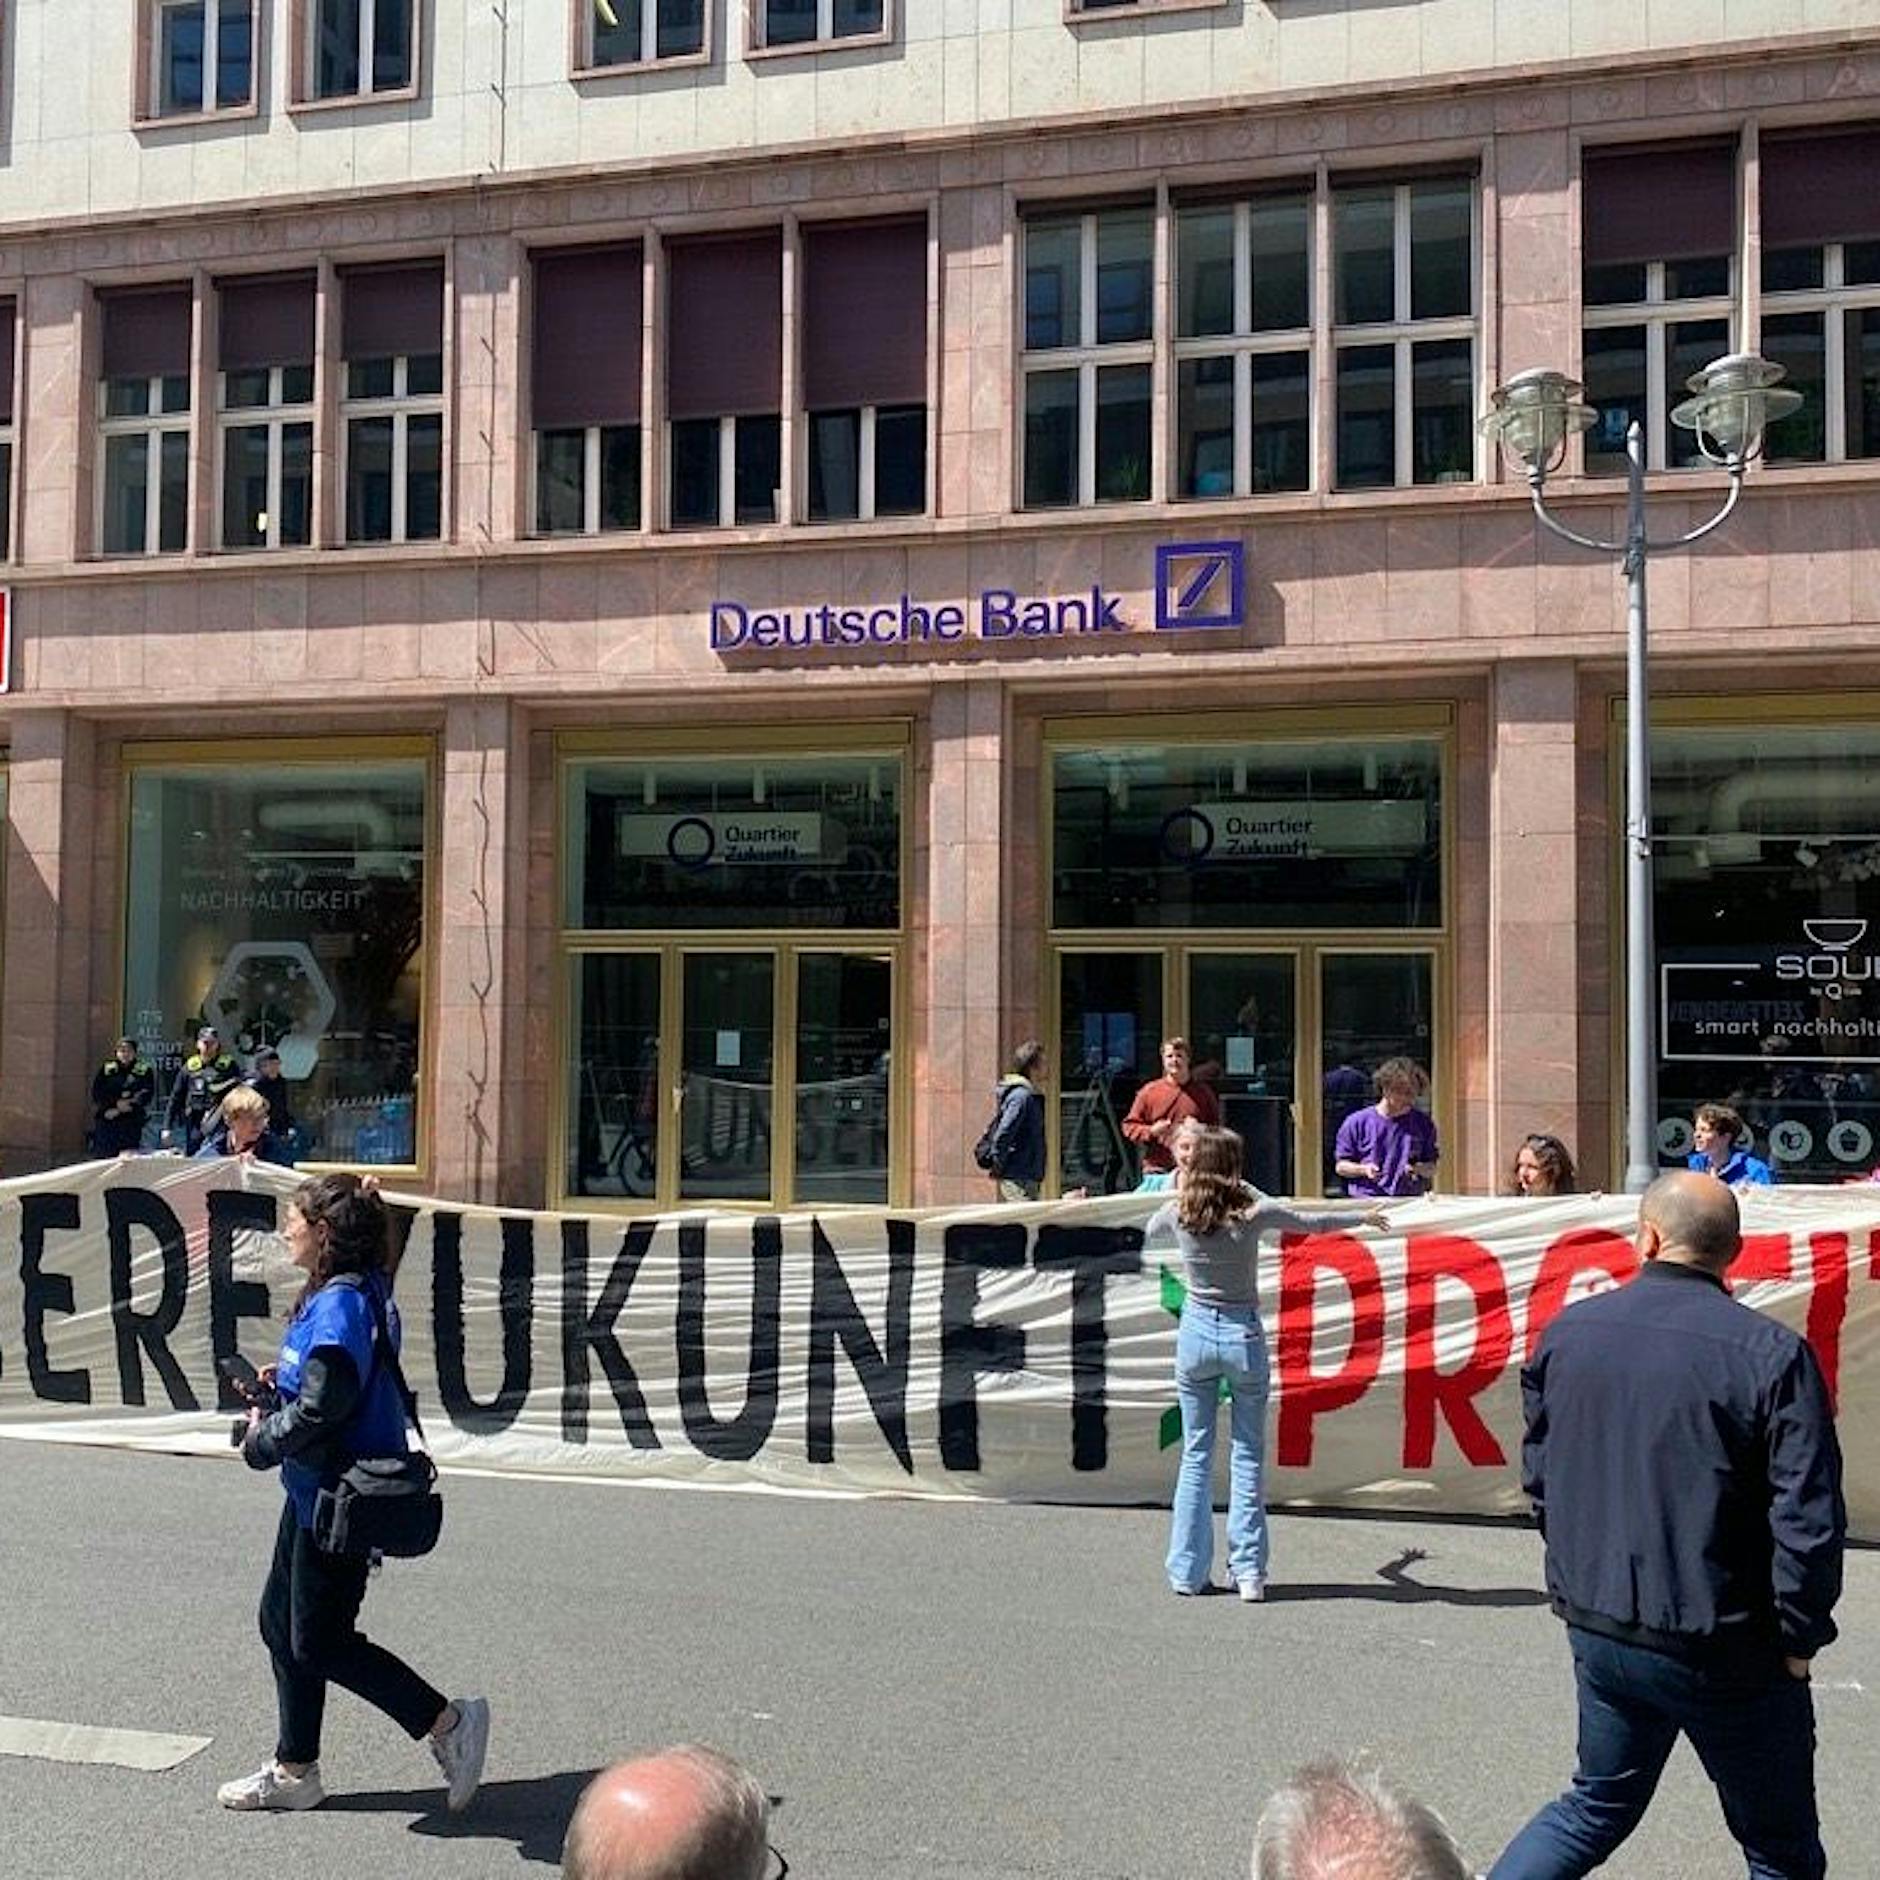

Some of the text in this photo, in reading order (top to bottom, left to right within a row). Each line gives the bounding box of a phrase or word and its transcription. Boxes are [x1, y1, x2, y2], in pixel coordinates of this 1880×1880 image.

[709, 585, 1125, 649] Deutsche Bank
[725, 826, 801, 843] Quartier
[1226, 817, 1314, 835] Quartier
[724, 845, 798, 862] Zukunft
[1226, 838, 1310, 856] Zukunft
[180, 889, 366, 909] NACHHALTIGKEIT
[1775, 955, 1880, 981] SOU
[137, 1026, 164, 1039] ALL
[1694, 1018, 1760, 1036] smart
[137, 1041, 184, 1055] ABOUT
[0, 1187, 278, 1413] ERE
[390, 1204, 1145, 1477] UKUNFT
